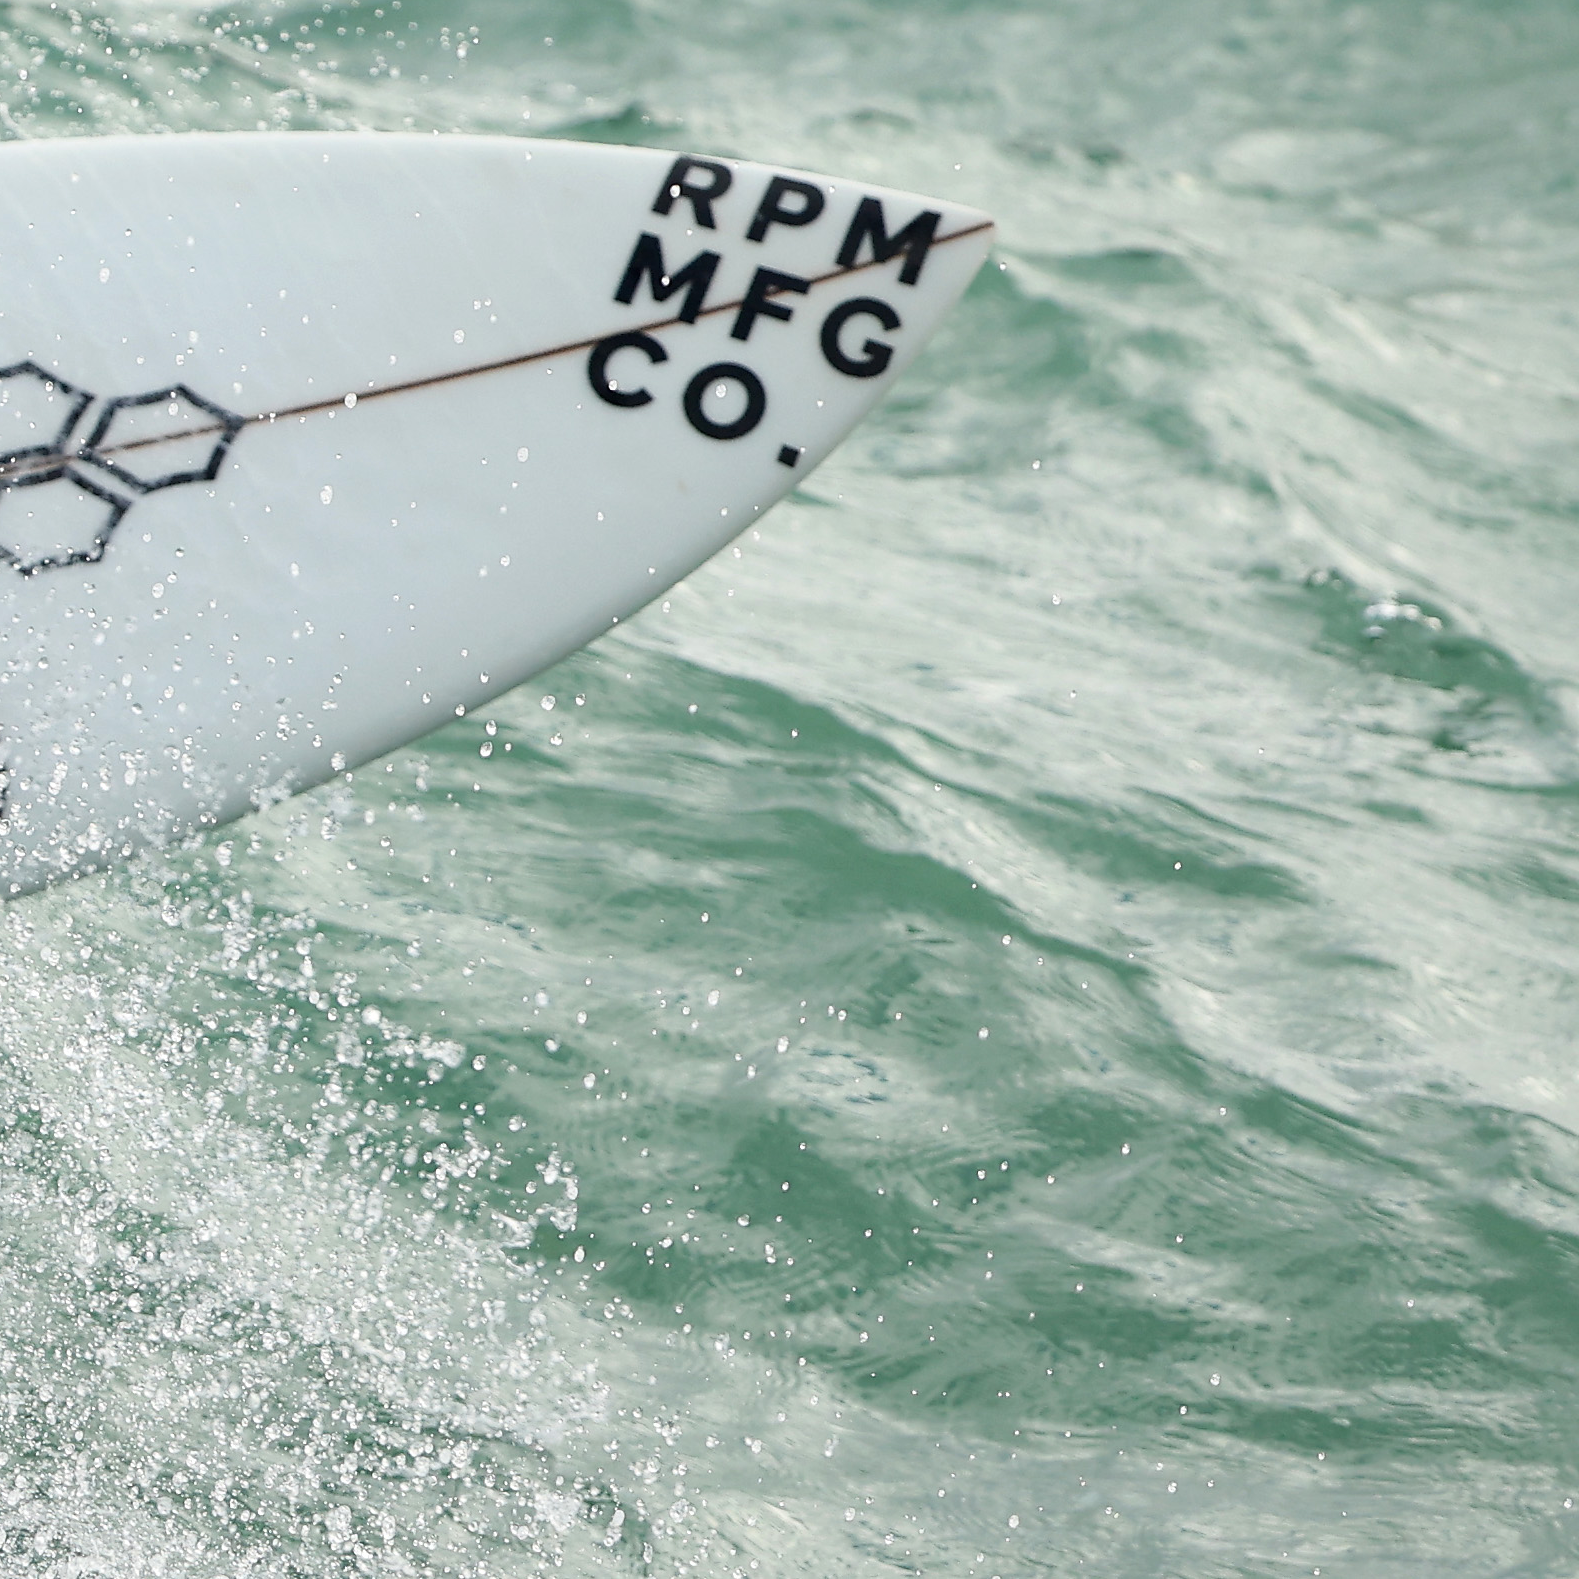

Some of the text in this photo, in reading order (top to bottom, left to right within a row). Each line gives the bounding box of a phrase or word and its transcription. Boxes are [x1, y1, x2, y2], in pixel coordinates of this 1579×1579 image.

[650, 154, 942, 287] RPM
[612, 230, 903, 380] MFG
[586, 330, 801, 469] CO.
